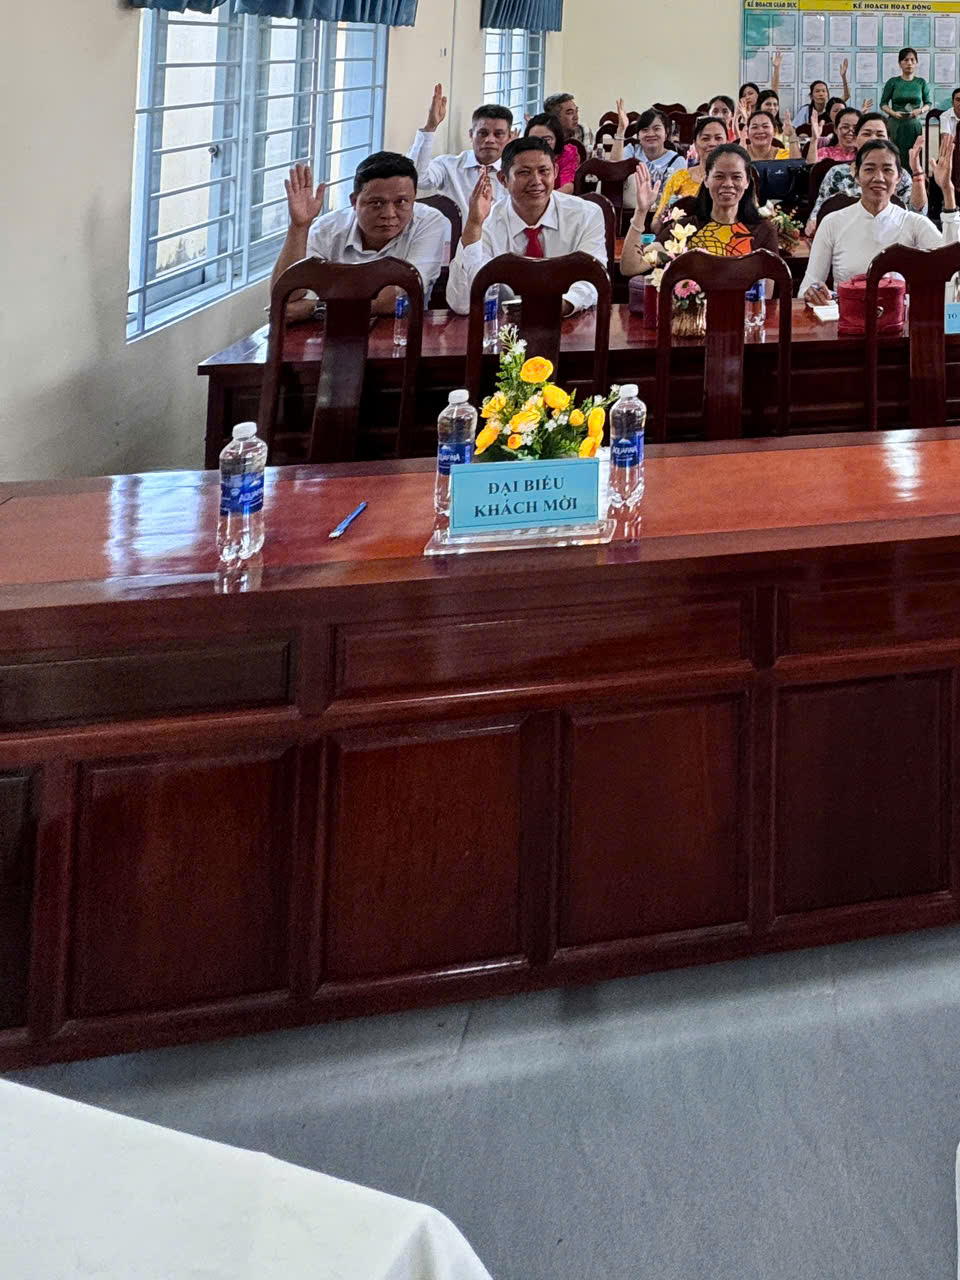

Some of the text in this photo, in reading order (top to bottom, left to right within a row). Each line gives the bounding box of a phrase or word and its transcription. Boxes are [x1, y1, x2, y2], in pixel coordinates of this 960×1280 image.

[488, 481, 518, 496] ĐẠI
[474, 495, 577, 517] KHÁCH MỜI
